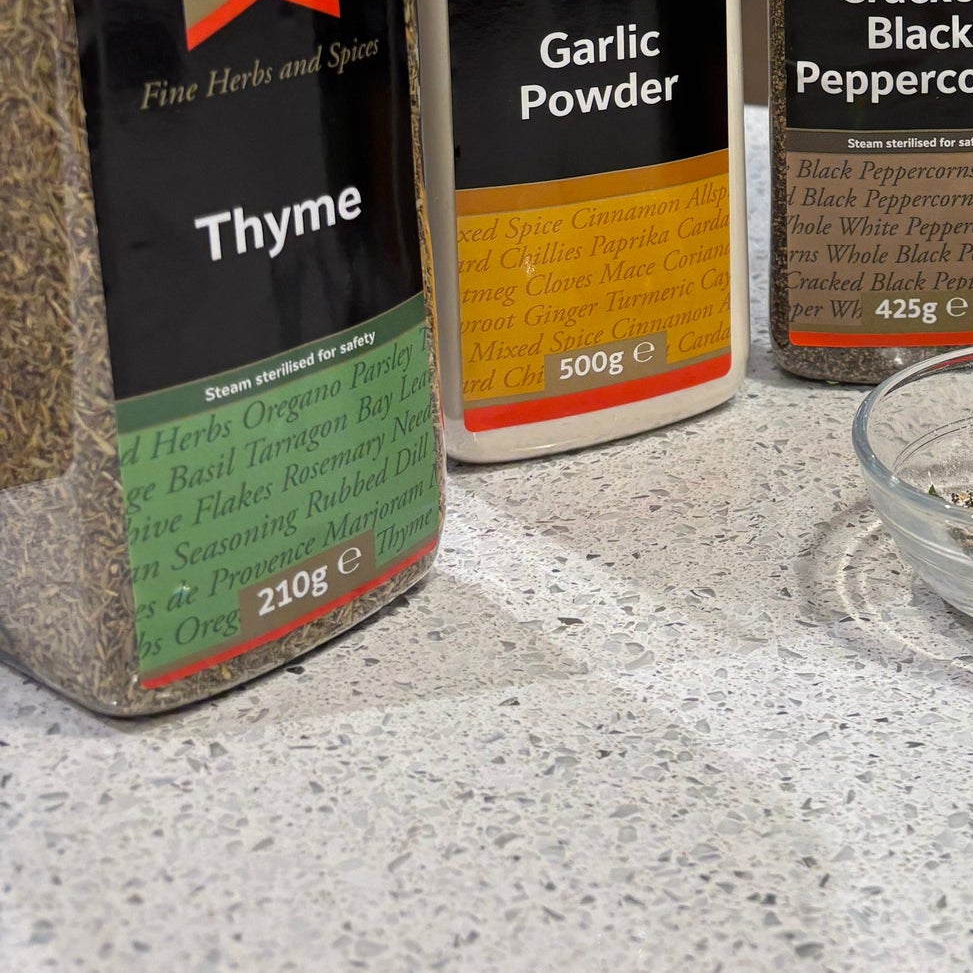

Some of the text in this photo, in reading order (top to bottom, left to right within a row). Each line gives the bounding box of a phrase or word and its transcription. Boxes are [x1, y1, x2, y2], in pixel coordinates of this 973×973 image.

[539, 23, 660, 69] Garlic
[867, 15, 973, 50] Black
[140, 36, 379, 110] Fine Herbs and Spices
[520, 71, 679, 120] Powder
[848, 138, 883, 148] Steam
[886, 138, 938, 148] sterilised
[940, 137, 956, 148] for
[796, 160, 851, 179] Black
[505, 216, 562, 244] Spice
[571, 198, 680, 229] Cinnamon
[685, 182, 729, 209] Allsp
[801, 187, 857, 207] Black
[194, 186, 362, 261] Thyme
[500, 241, 582, 269] Chillies
[590, 226, 670, 259] Paprika
[787, 213, 832, 236] hole
[840, 217, 899, 236] White
[526, 268, 592, 296] Cloves
[599, 259, 655, 284] Mace
[663, 243, 730, 271] Corian
[826, 244, 888, 264] Whole
[895, 243, 951, 264] Black
[524, 299, 598, 326] Ginger
[605, 277, 695, 312] Turmeric
[786, 270, 862, 291] Cracked
[870, 271, 925, 291] Black
[468, 333, 544, 363] Mixed
[550, 327, 604, 351] Spice
[612, 302, 713, 338] Cinnamon
[875, 299, 938, 323] 425g
[205, 331, 376, 402] Steam sterilised for safety
[560, 349, 624, 379] 500g
[150, 419, 232, 460] Herbs
[242, 380, 341, 429] Oregano
[349, 342, 414, 390] Parsley
[170, 457, 235, 495] Basil
[244, 415, 348, 470] Tarragon
[358, 390, 394, 424] Bay
[398, 367, 432, 403] Lea
[172, 504, 299, 572] Seasoning
[306, 460, 387, 519] Rubbed
[395, 435, 429, 477] Dill
[194, 480, 272, 526] Flakes
[282, 433, 386, 491] Rosemary
[167, 484, 424, 614] de Provence Marjoram
[376, 508, 433, 556] Thyme
[256, 563, 328, 616] 210g
